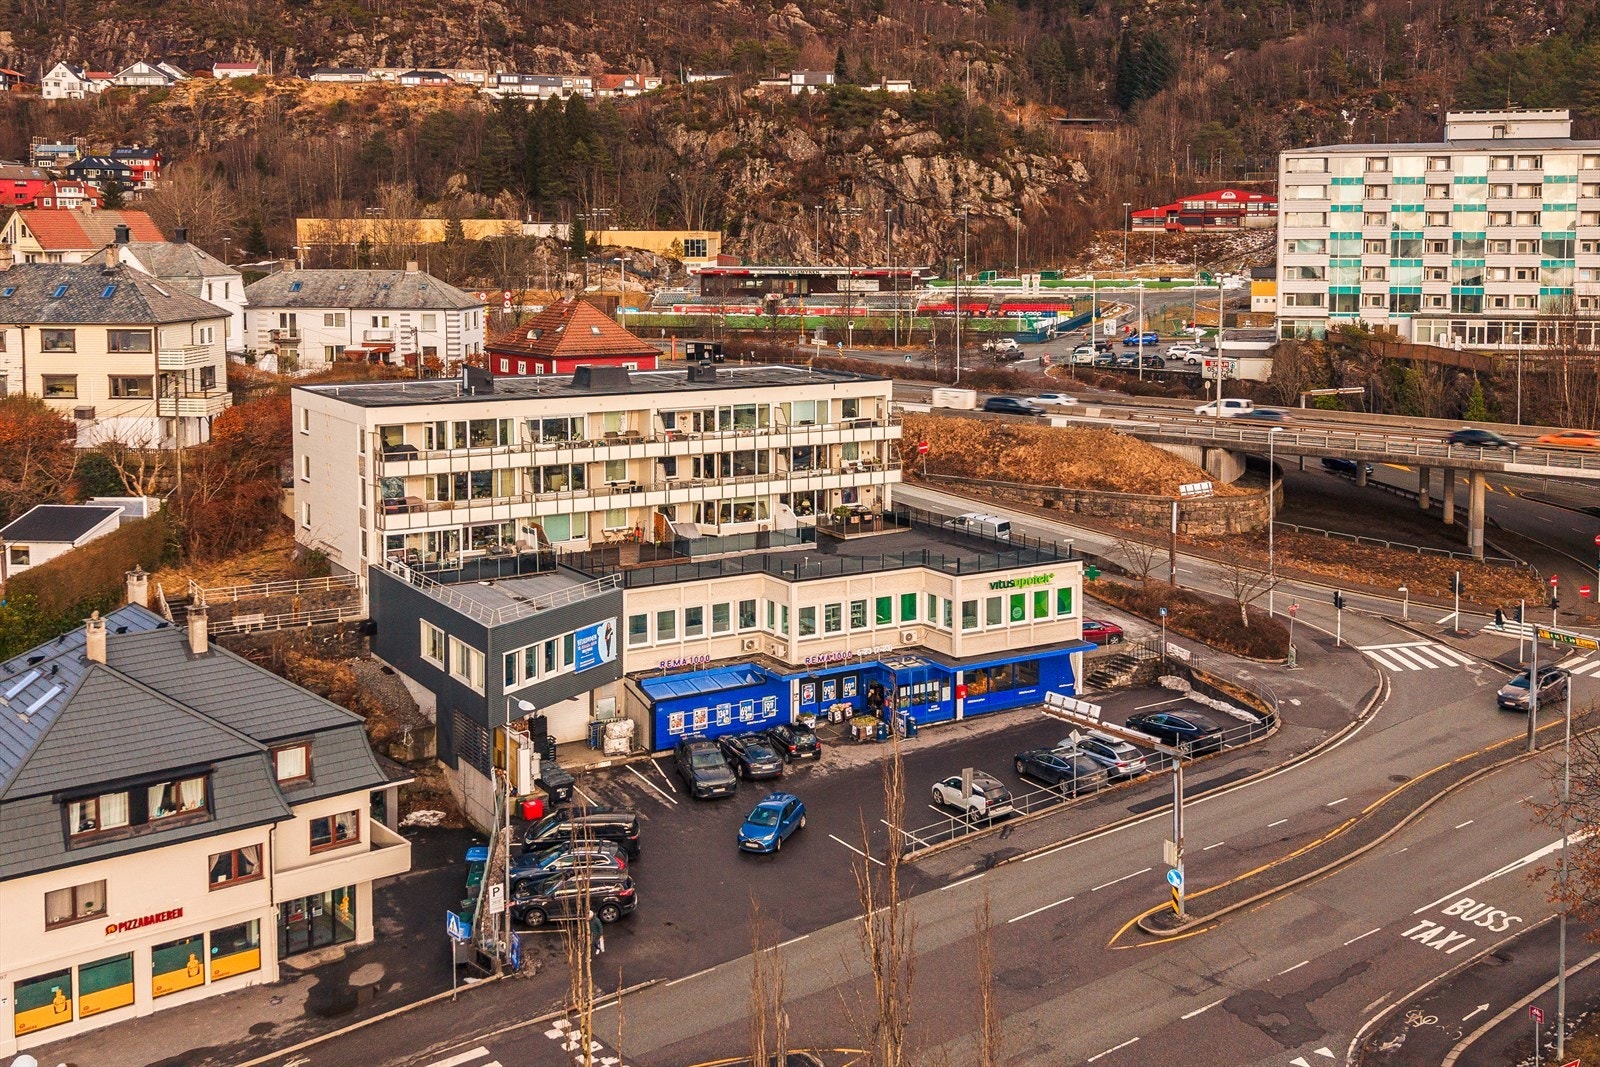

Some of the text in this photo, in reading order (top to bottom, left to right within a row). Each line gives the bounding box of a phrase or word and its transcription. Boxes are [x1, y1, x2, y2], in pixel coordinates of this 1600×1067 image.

[660, 654, 710, 669] REMA 1000
[804, 650, 853, 665] REMA 1000
[492, 886, 500, 898] P
[118, 907, 183, 934] PIZZABAKEREN
[1441, 897, 1523, 932] BUSS
[1400, 919, 1476, 954] TAXI
